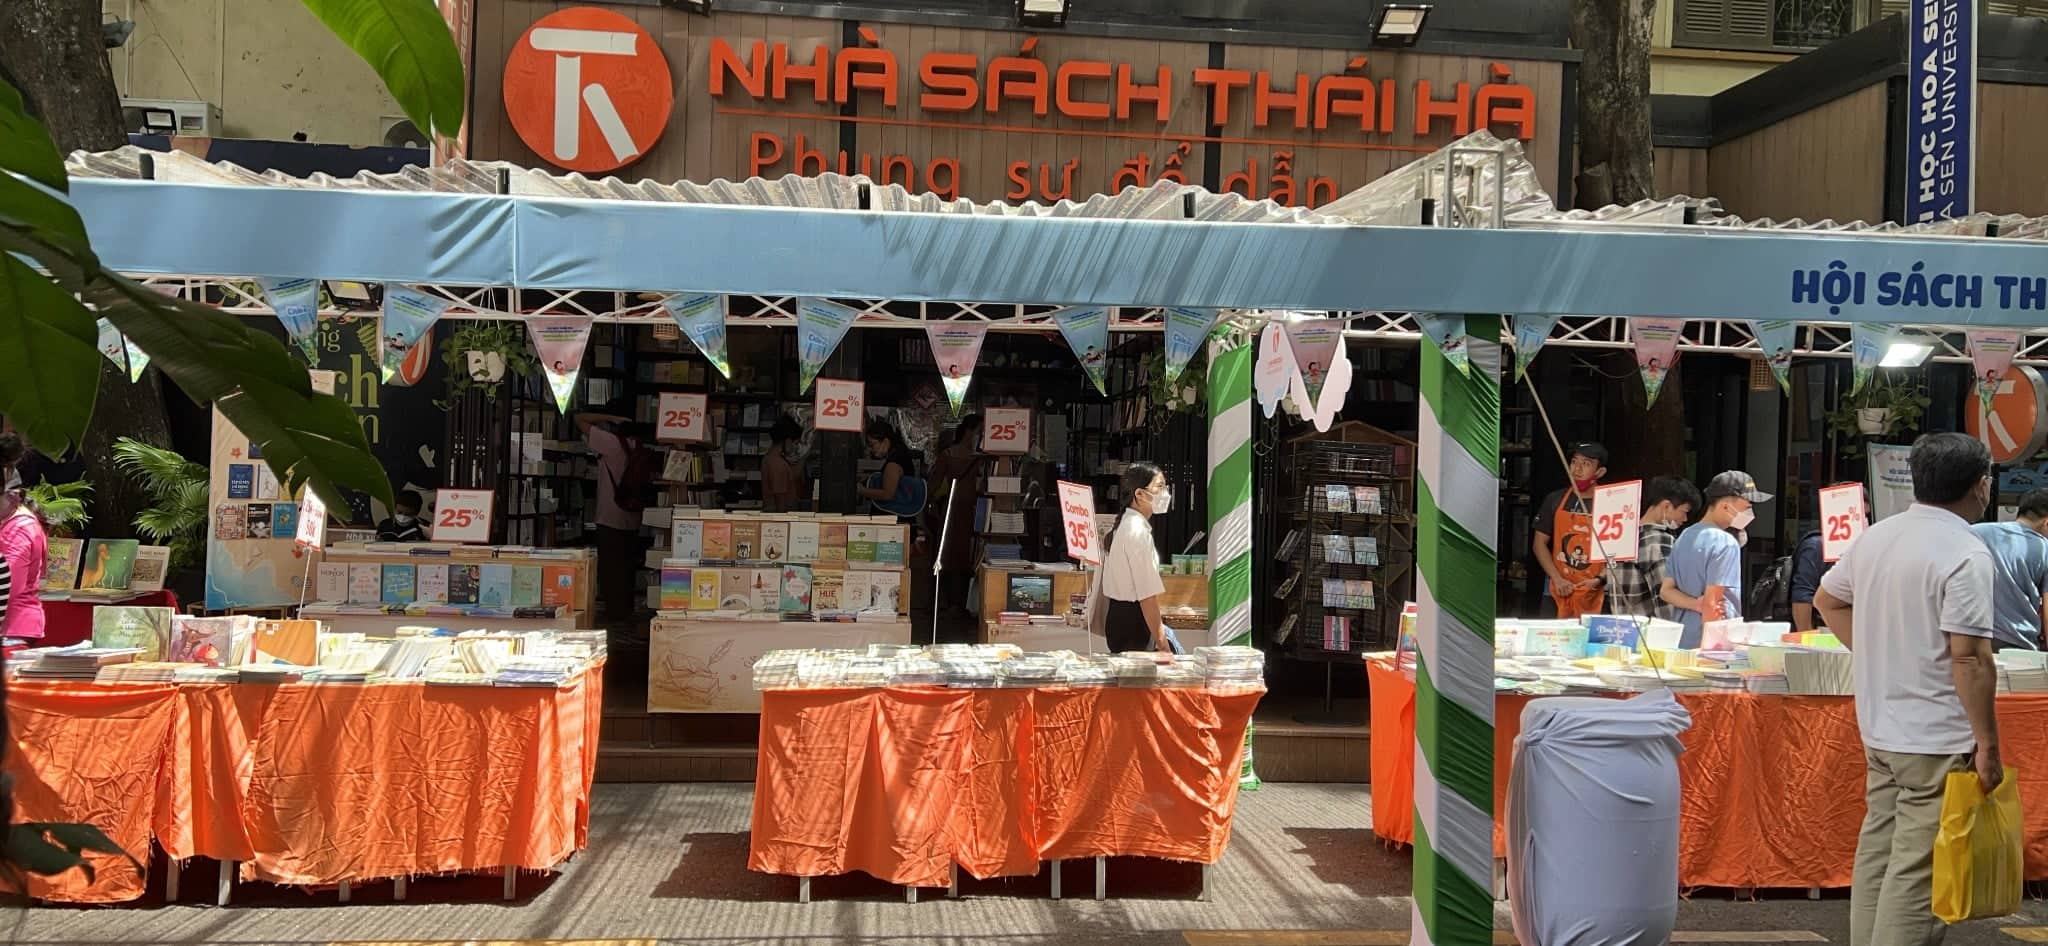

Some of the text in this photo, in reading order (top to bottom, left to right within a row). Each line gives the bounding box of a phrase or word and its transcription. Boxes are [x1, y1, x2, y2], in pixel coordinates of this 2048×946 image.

[709, 27, 897, 107] NHÀ
[920, 37, 1172, 121] SÁCH
[1194, 56, 1394, 135] THÁI
[1415, 62, 1535, 140] HÀ
[1921, 47, 1938, 124] HOA
[1920, 130, 1939, 203] HỌC
[1940, 140, 1955, 196] SEN
[1791, 260, 1866, 315] HỘI
[1877, 261, 1983, 308] SÁCH
[663, 406, 701, 428] 25%
[822, 395, 860, 417] 25%
[991, 420, 1026, 441] 25%
[439, 508, 485, 528] 25%
[1065, 501, 1089, 518] Combo
[1598, 504, 1635, 541] 25%
[1828, 506, 1861, 541] 25%
[1069, 520, 1095, 550] 35%
